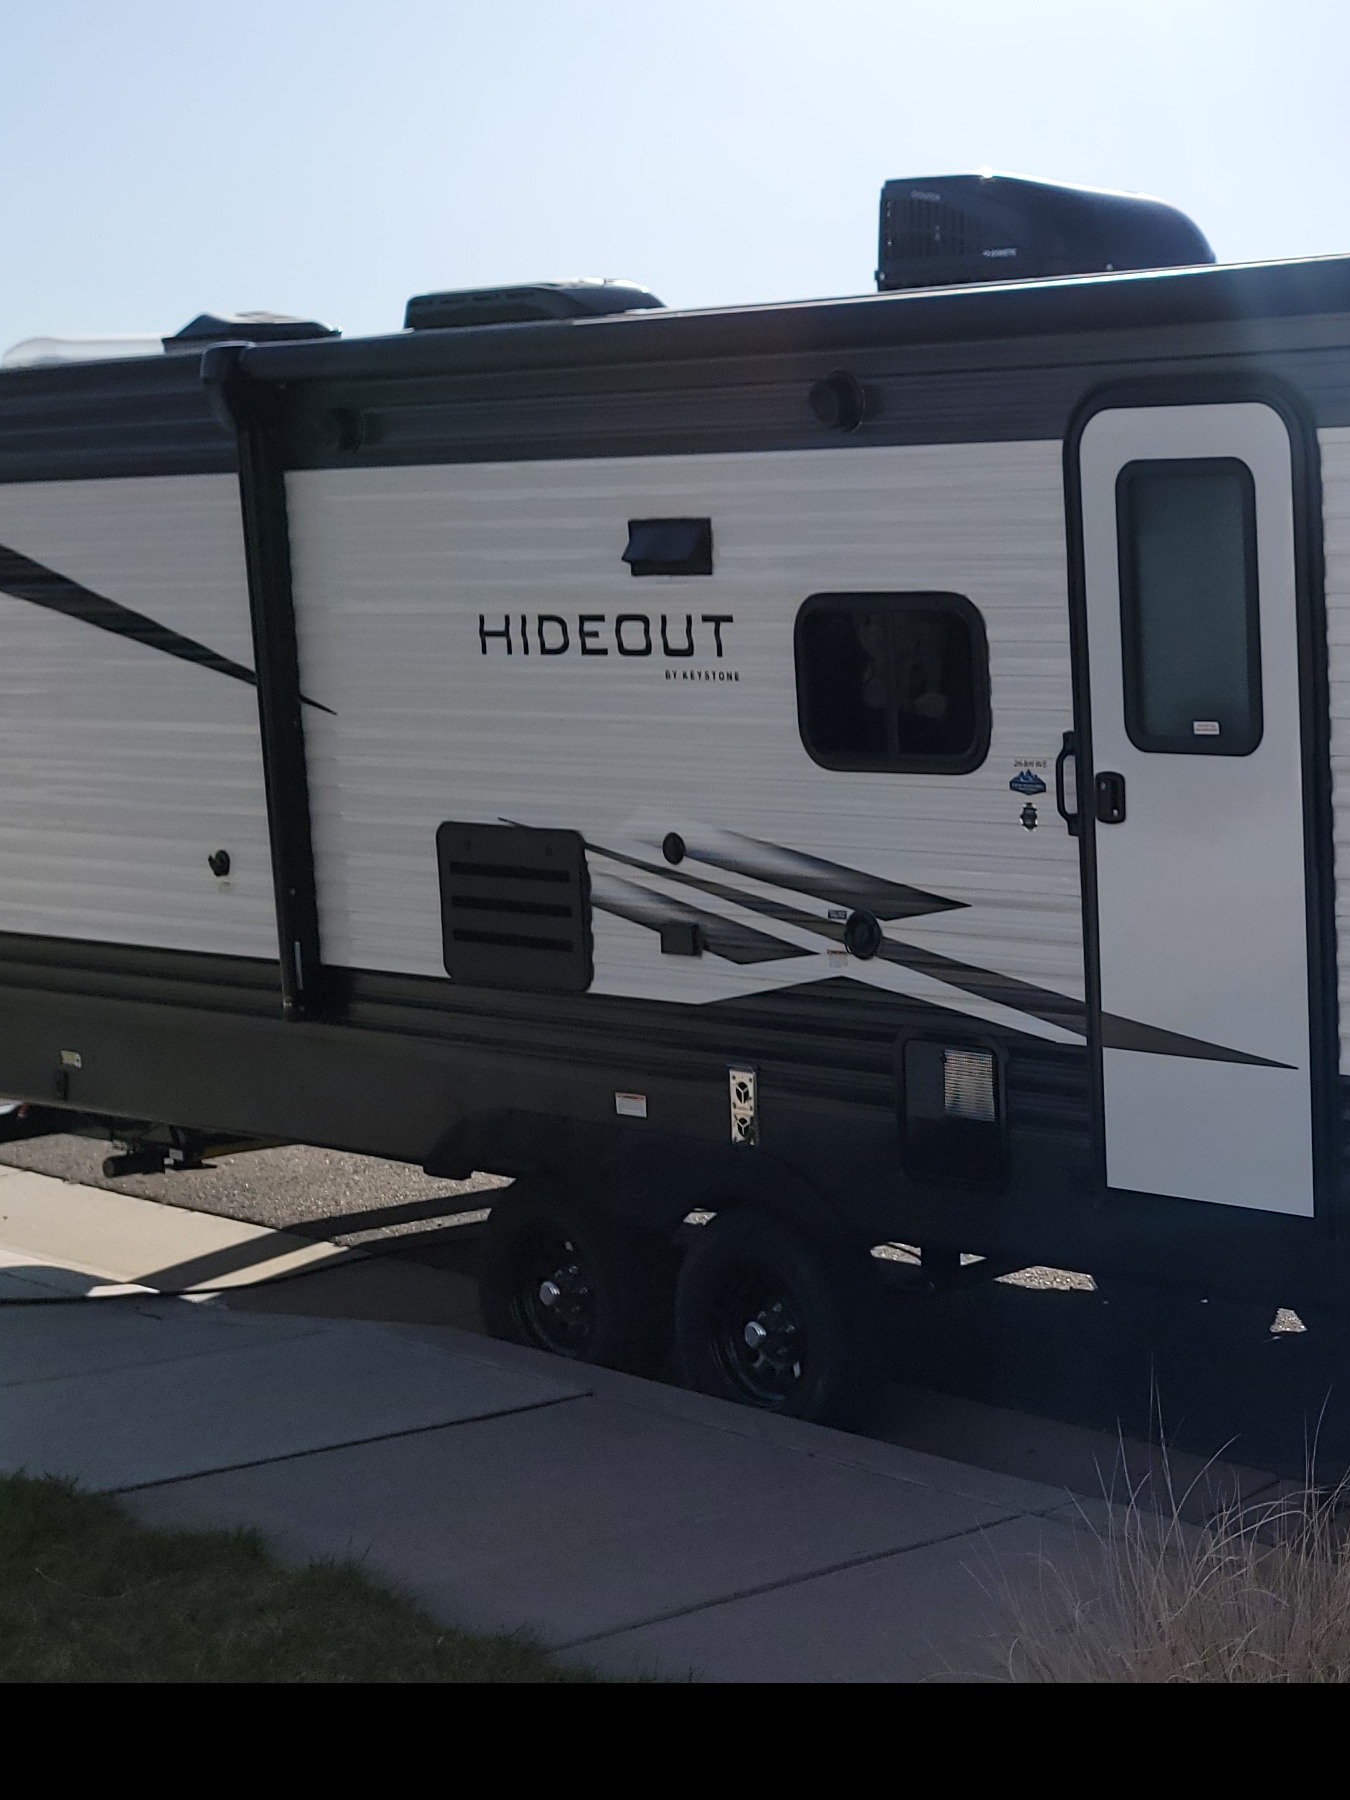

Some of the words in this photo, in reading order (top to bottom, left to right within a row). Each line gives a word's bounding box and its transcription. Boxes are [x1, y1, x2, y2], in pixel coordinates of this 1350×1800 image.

[478, 613, 734, 657] HIDEOUT
[664, 669, 677, 681] BY
[682, 670, 740, 682] KEYSTONE
